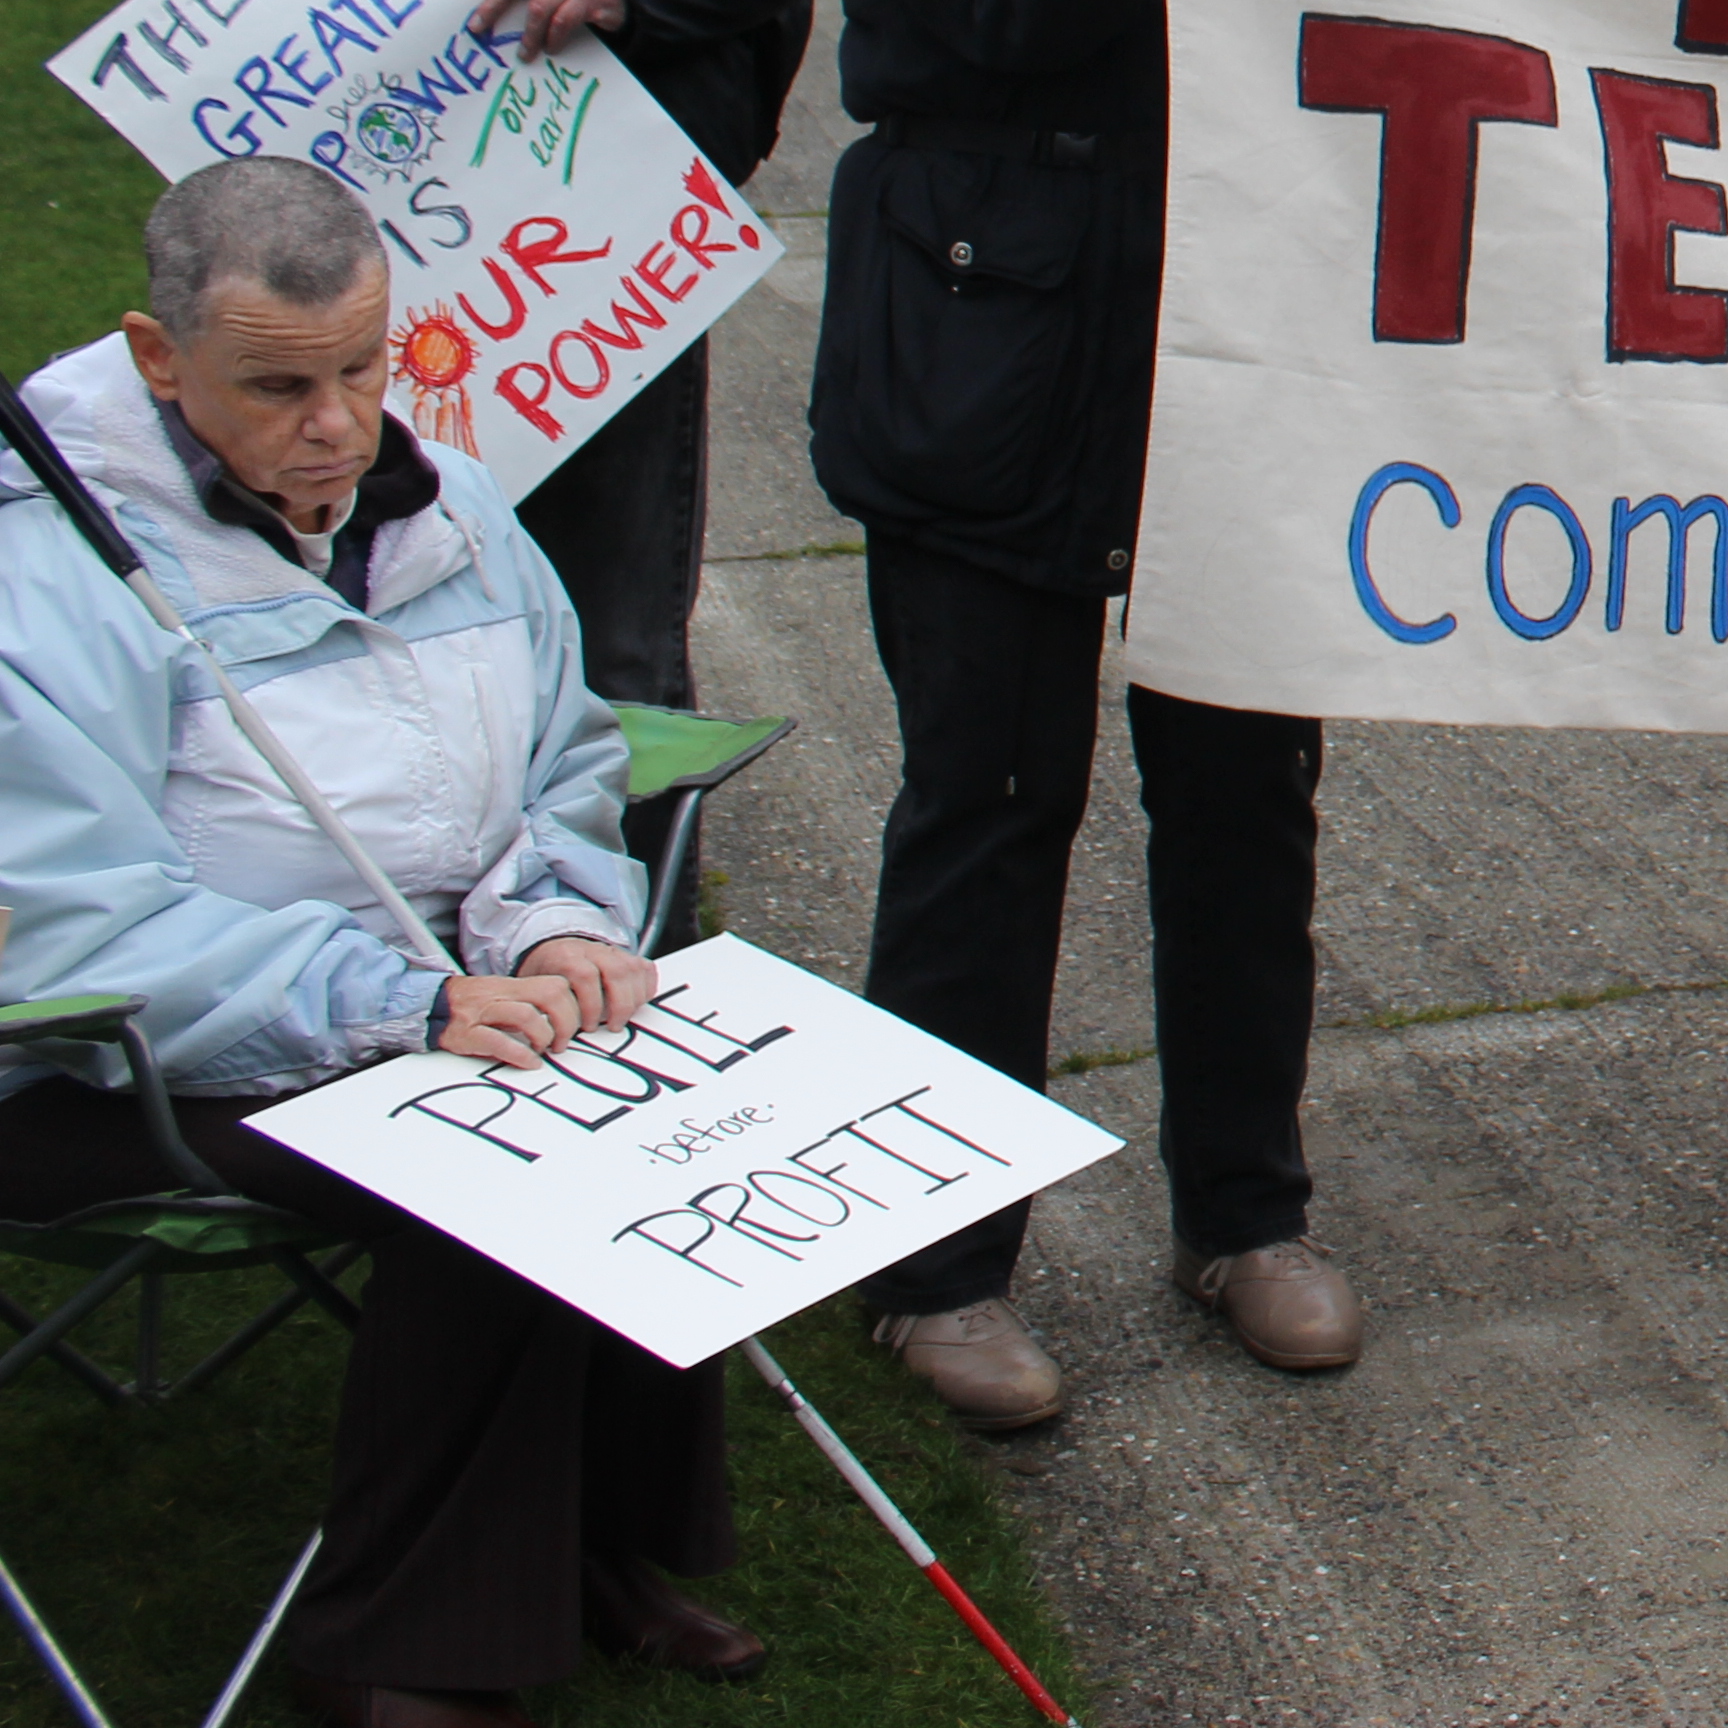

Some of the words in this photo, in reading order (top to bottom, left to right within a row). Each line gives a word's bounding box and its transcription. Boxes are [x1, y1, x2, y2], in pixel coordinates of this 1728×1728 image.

[530, 57, 584, 167] earth
[379, 176, 473, 269] IS
[494, 156, 760, 443] POWER!
[612, 1085, 1011, 1288] PROFIT
